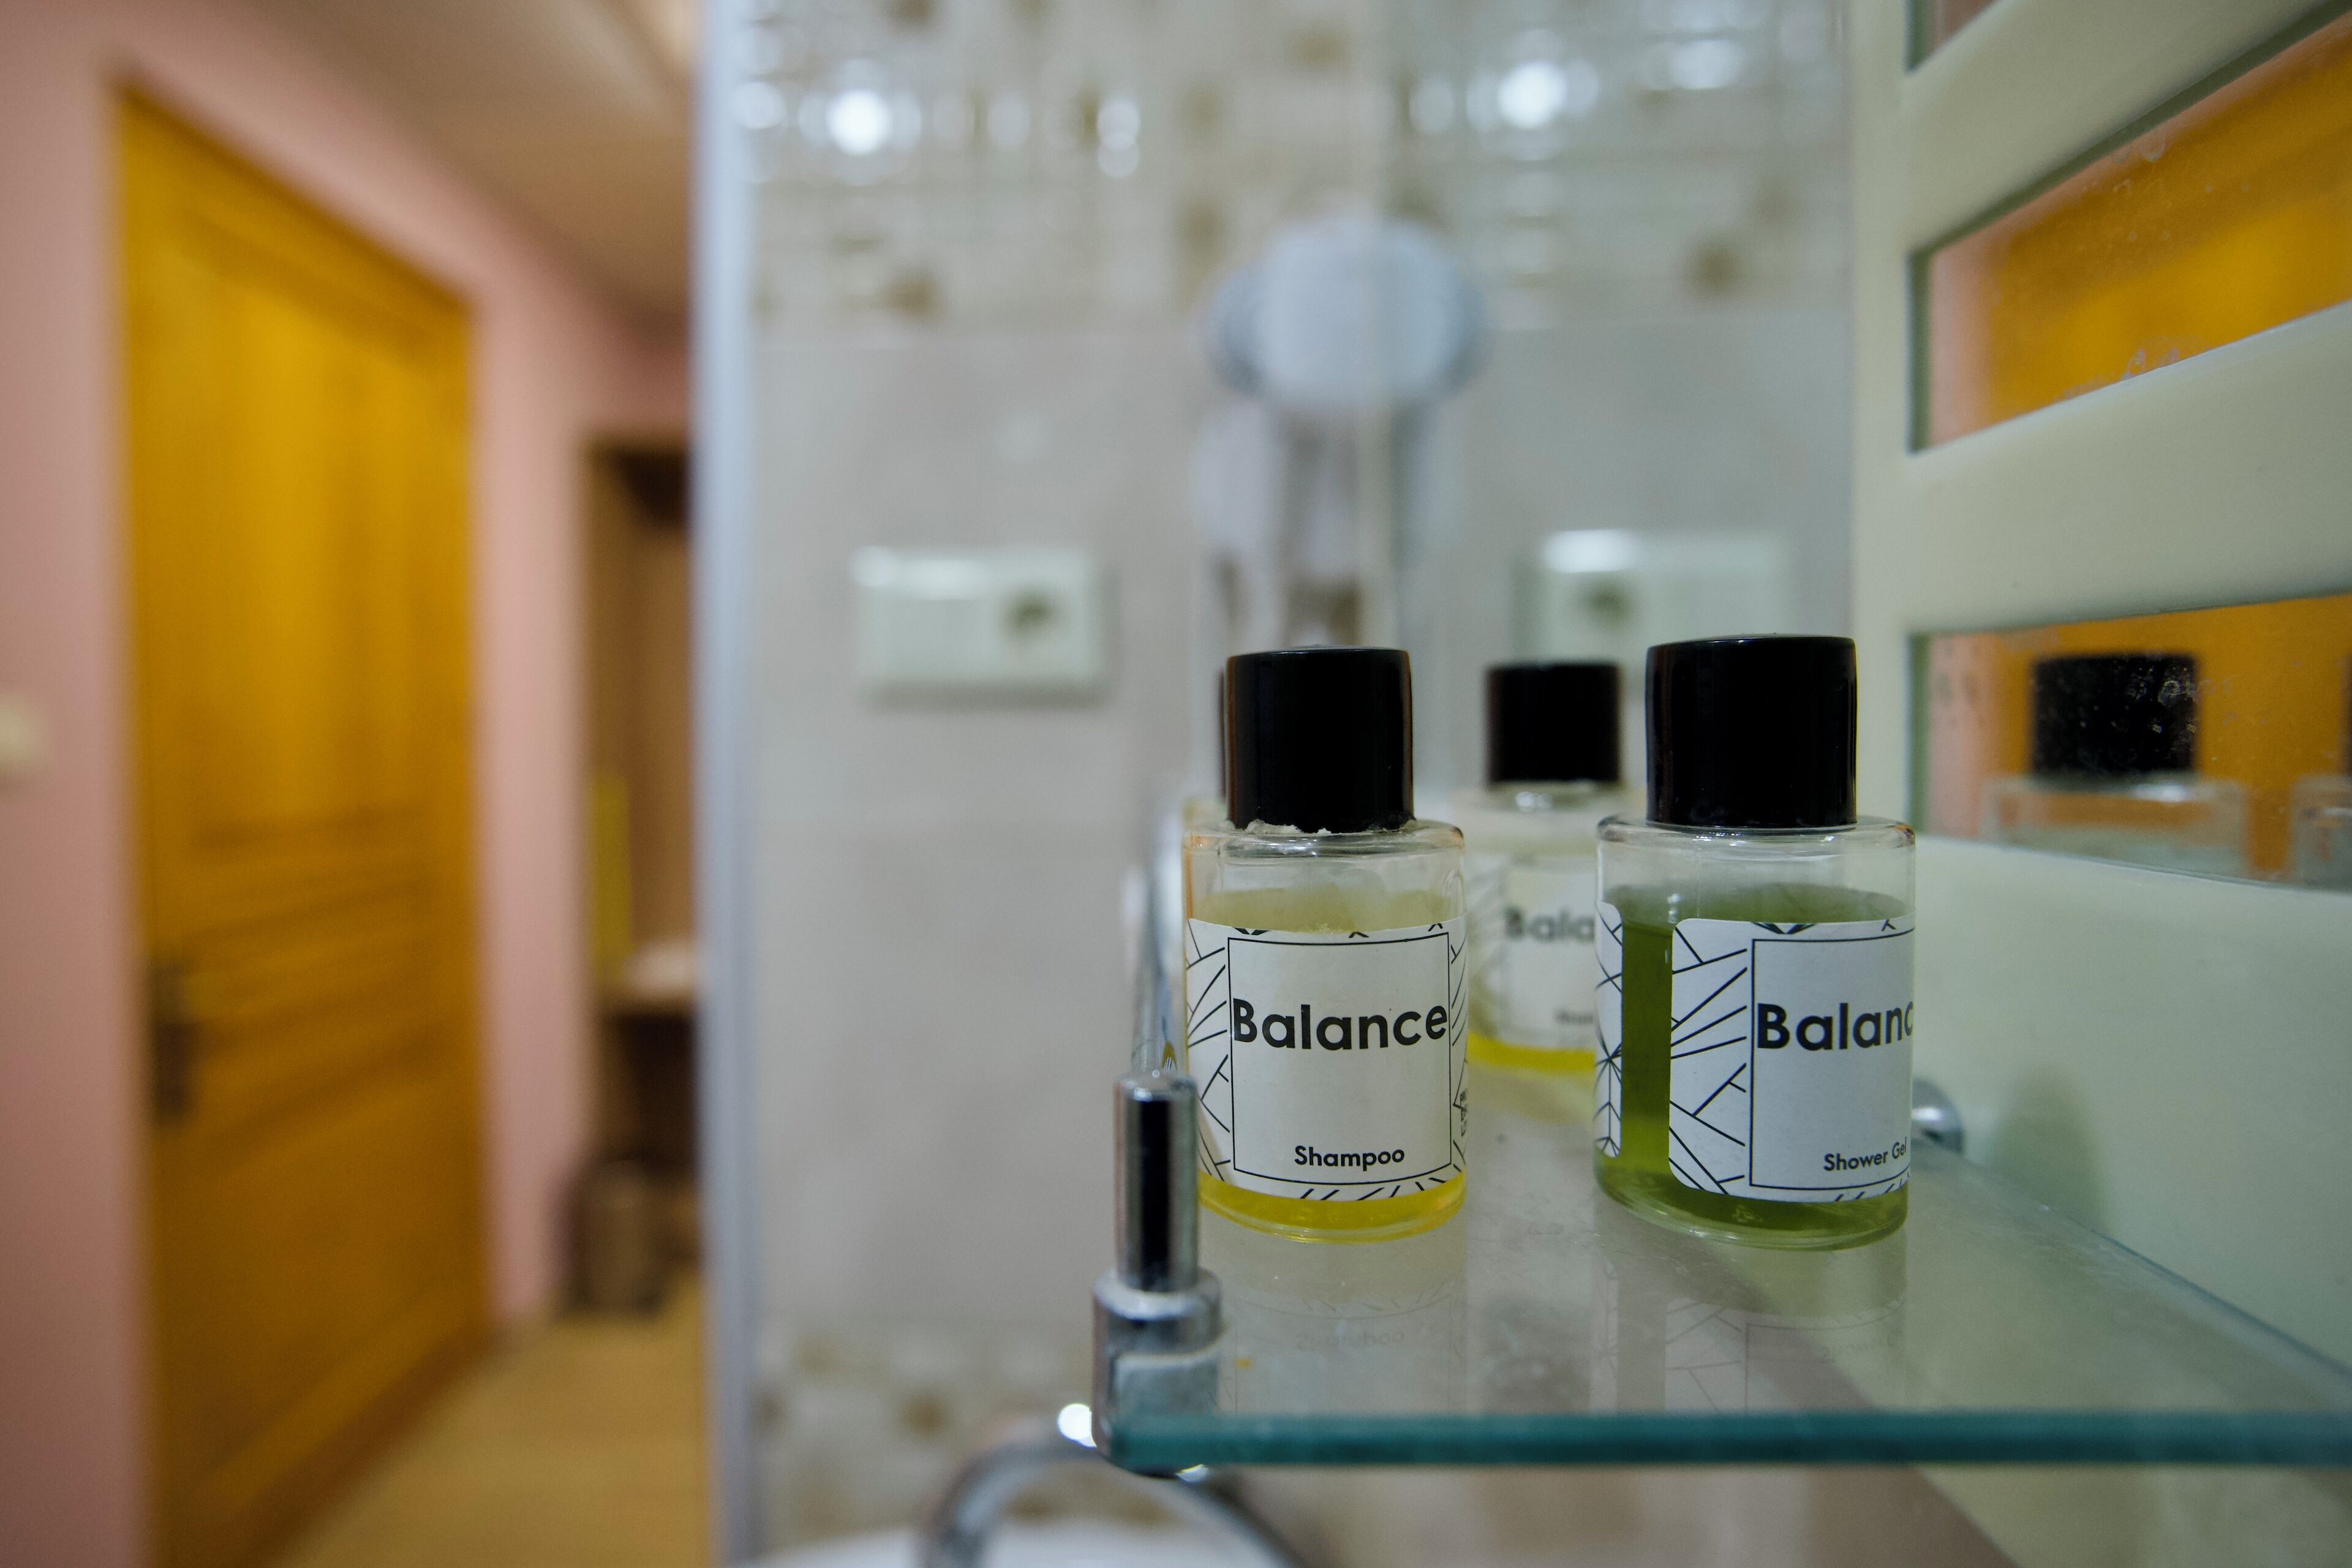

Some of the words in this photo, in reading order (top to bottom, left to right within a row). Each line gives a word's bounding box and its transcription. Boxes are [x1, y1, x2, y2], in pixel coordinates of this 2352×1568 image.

[1233, 998, 1449, 1051] Balance
[1294, 1145, 1406, 1172] Shampoo
[1823, 1151, 1888, 1171] Shower
[1892, 1136, 1907, 1159] Gel
